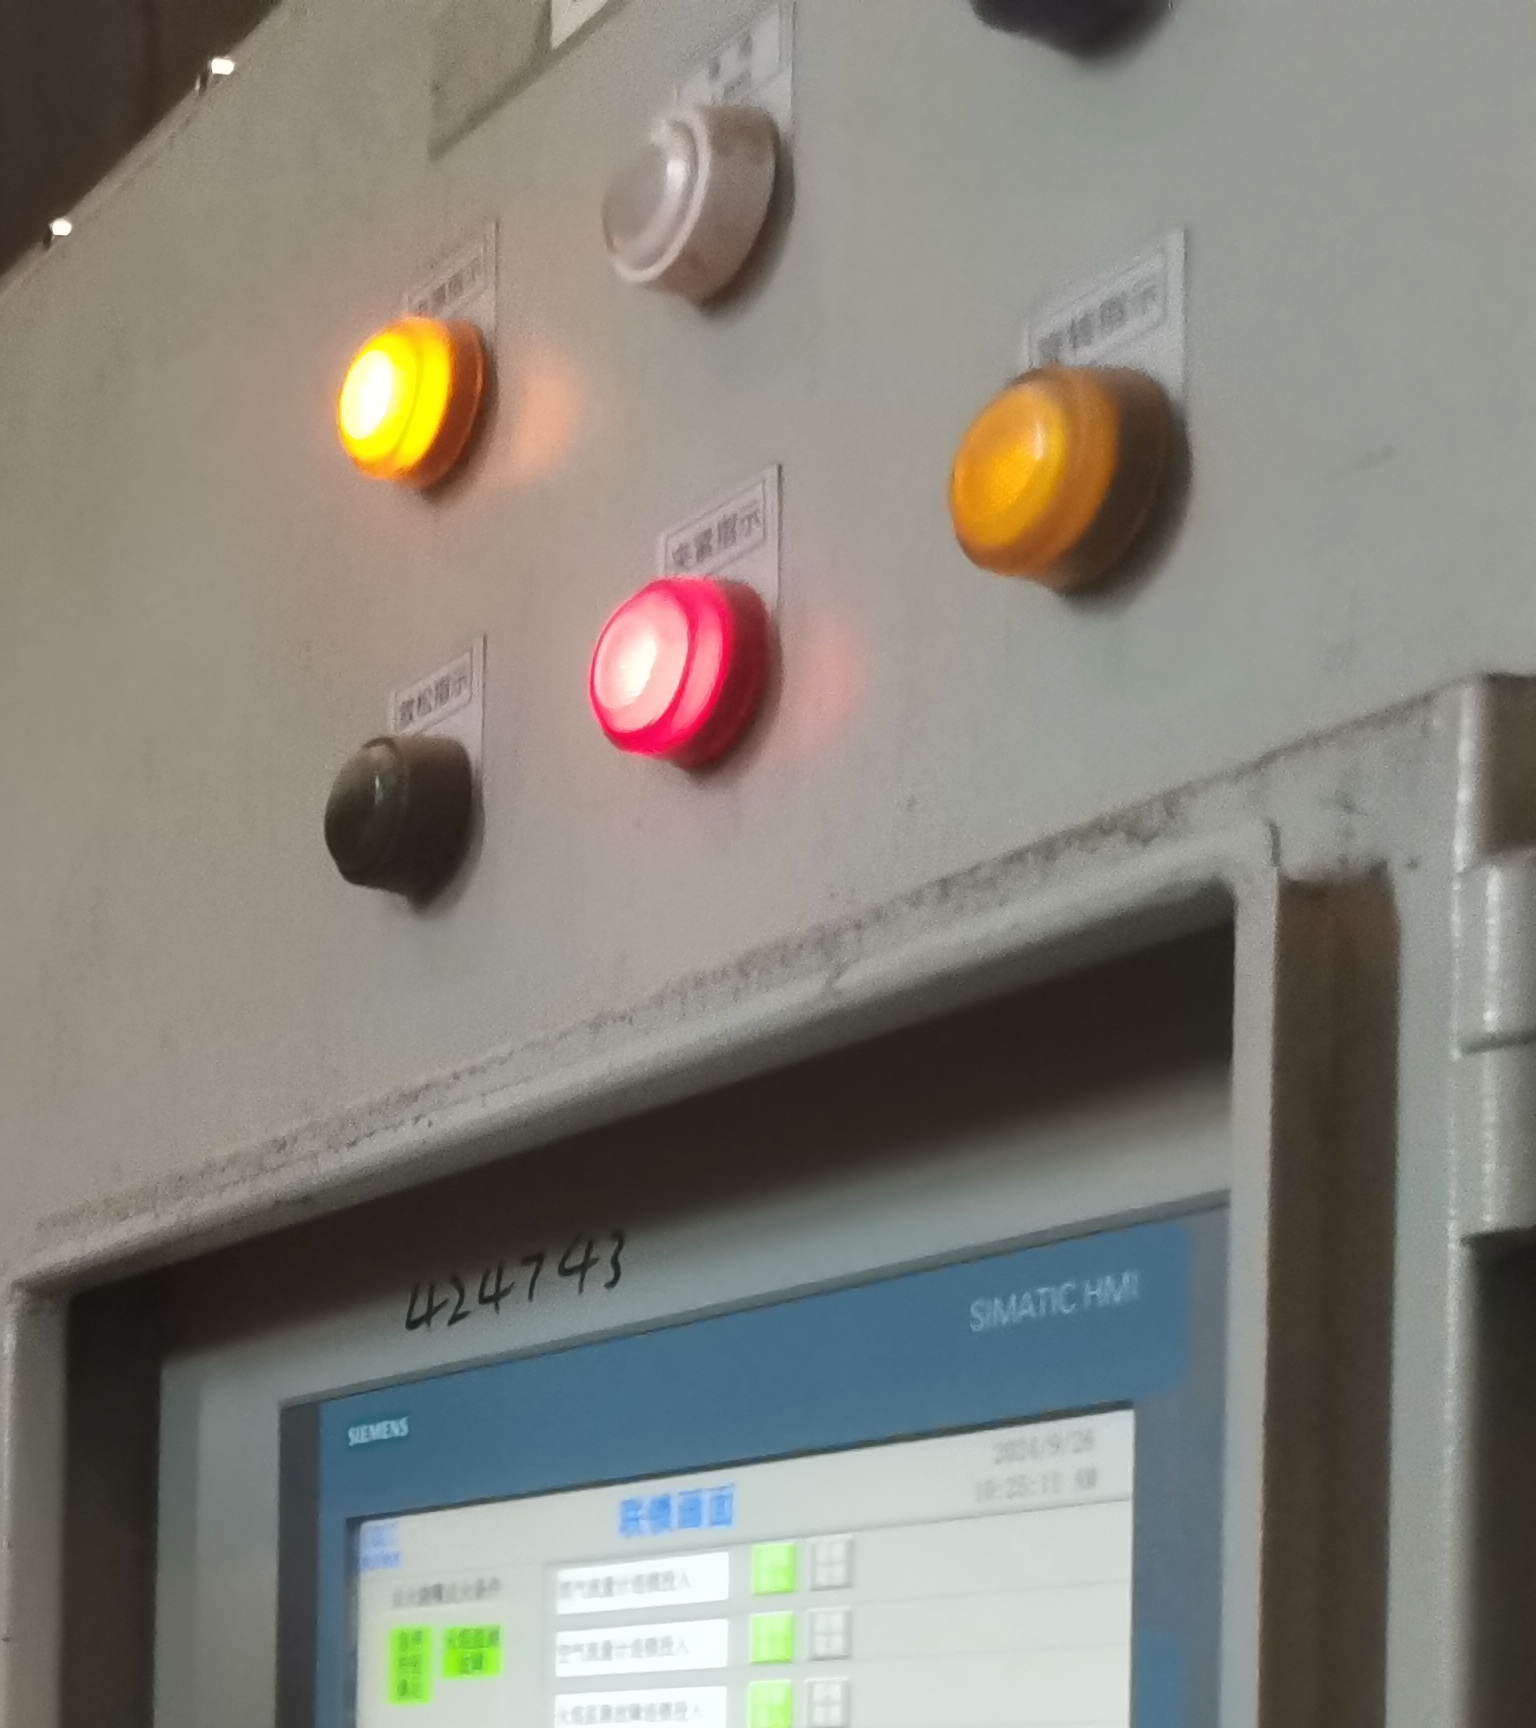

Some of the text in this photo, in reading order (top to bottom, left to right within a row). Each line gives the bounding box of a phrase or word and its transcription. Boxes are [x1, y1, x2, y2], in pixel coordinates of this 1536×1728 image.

[405, 1231, 625, 1331] 424743
[969, 1271, 1140, 1333] SIMATIC HMI
[347, 1416, 410, 1447] SIEMENS
